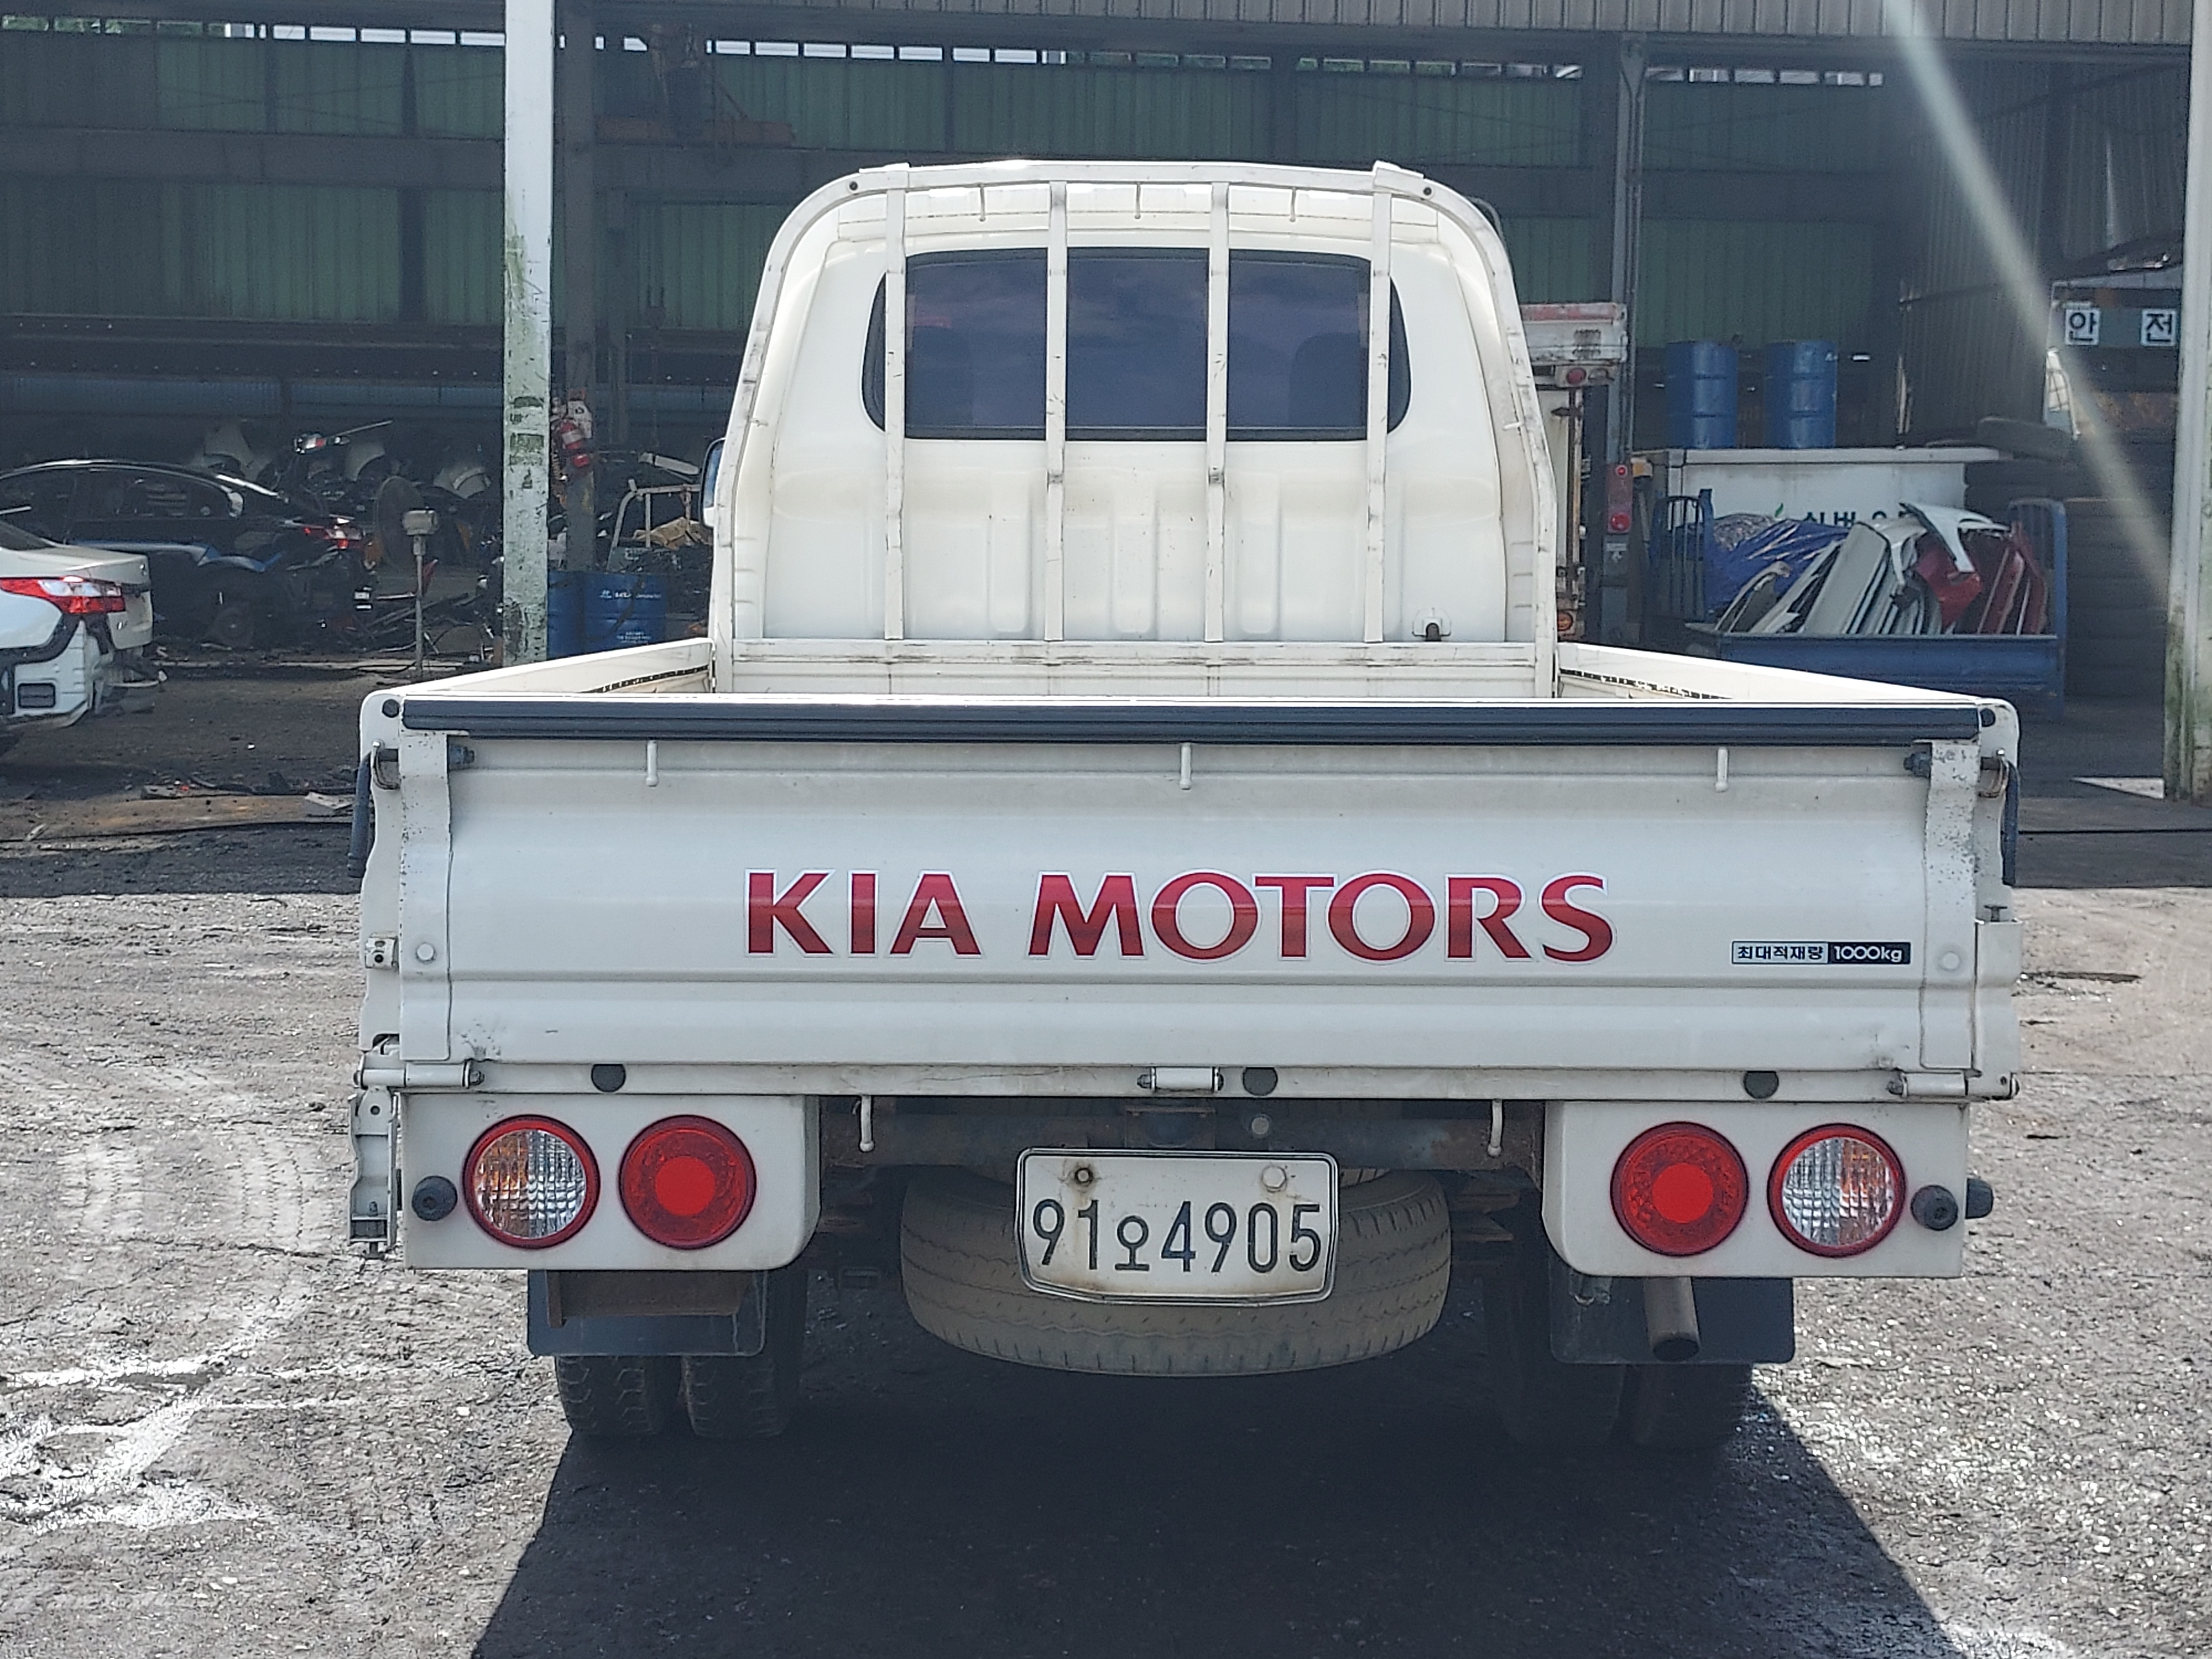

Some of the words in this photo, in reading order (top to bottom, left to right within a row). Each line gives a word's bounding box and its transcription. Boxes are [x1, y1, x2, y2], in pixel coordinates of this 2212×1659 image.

[747, 871, 981, 955] KIA
[1029, 871, 1612, 962] MOTORS
[1738, 945, 1824, 961] 최대적재량
[1833, 945, 1903, 963] 1000kg
